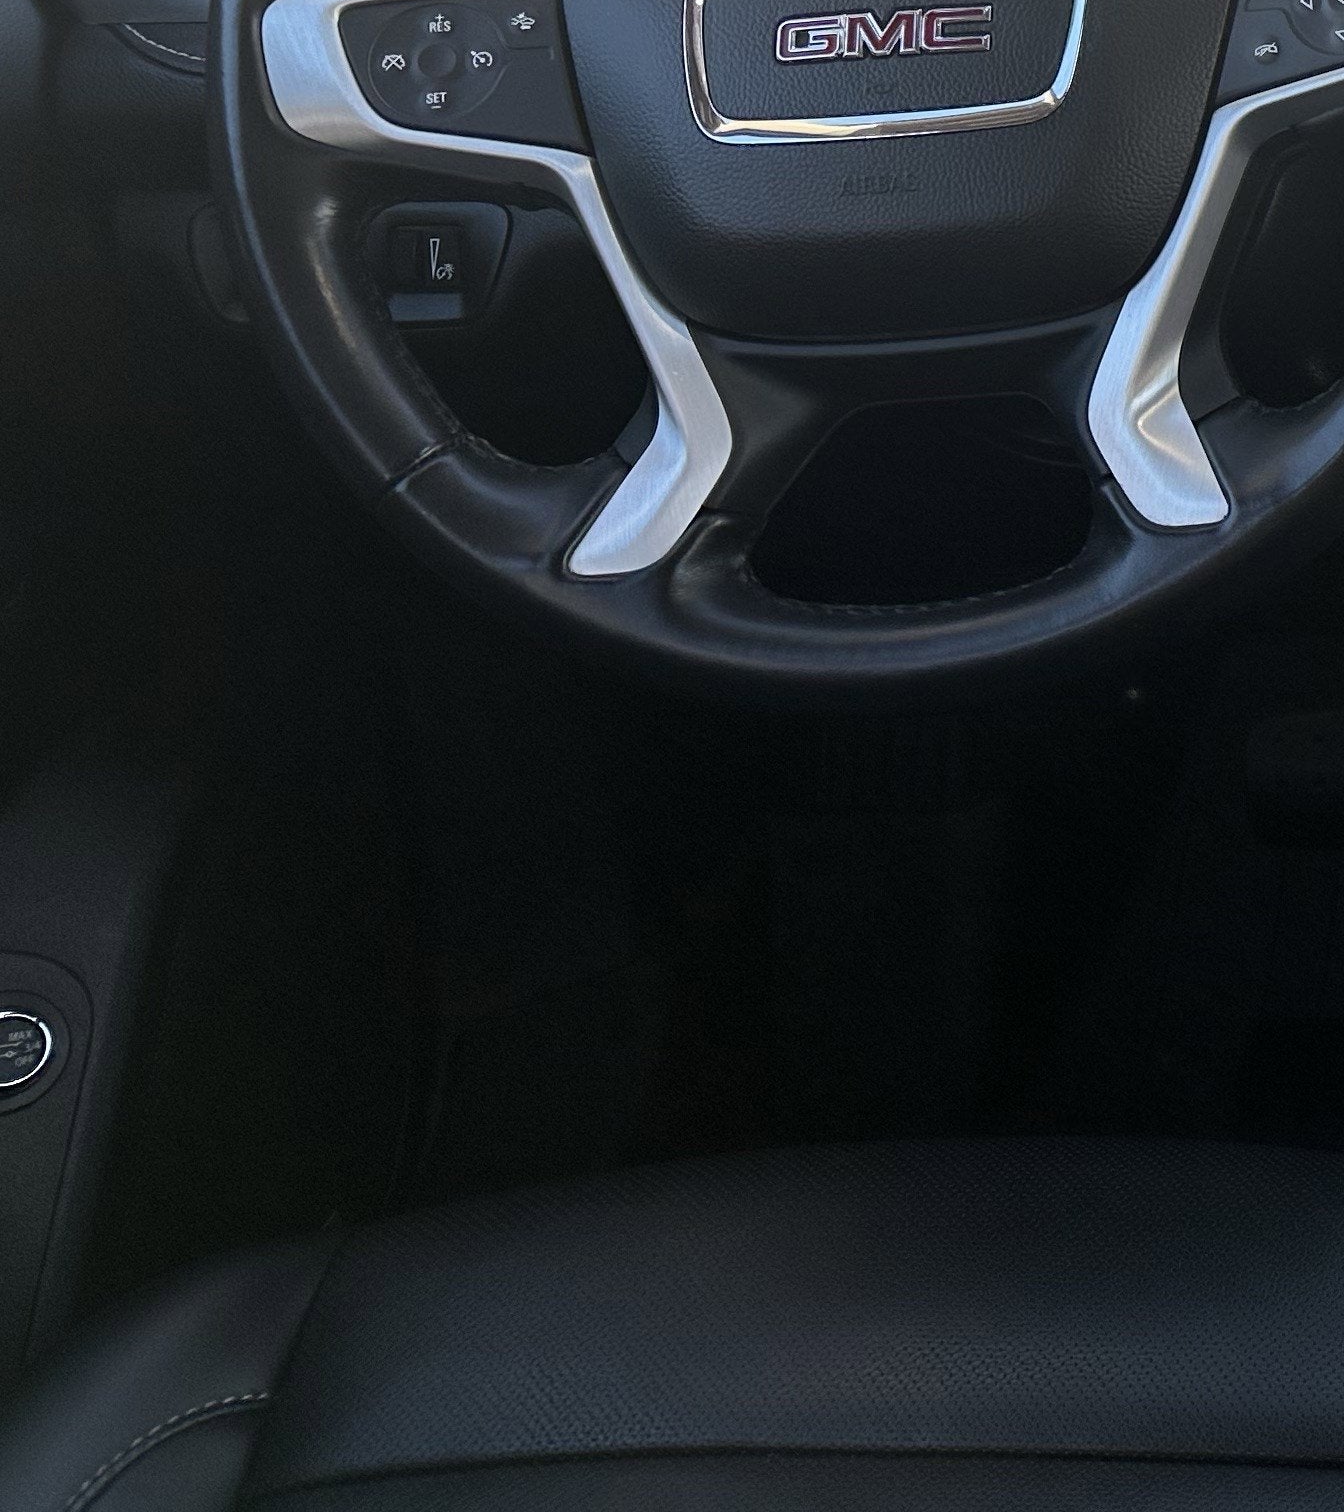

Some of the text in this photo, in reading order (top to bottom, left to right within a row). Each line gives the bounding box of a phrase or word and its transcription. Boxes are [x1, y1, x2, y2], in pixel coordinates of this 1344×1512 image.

[428, 20, 451, 33] RES
[774, 3, 995, 66] GMC
[425, 91, 447, 104] SET
